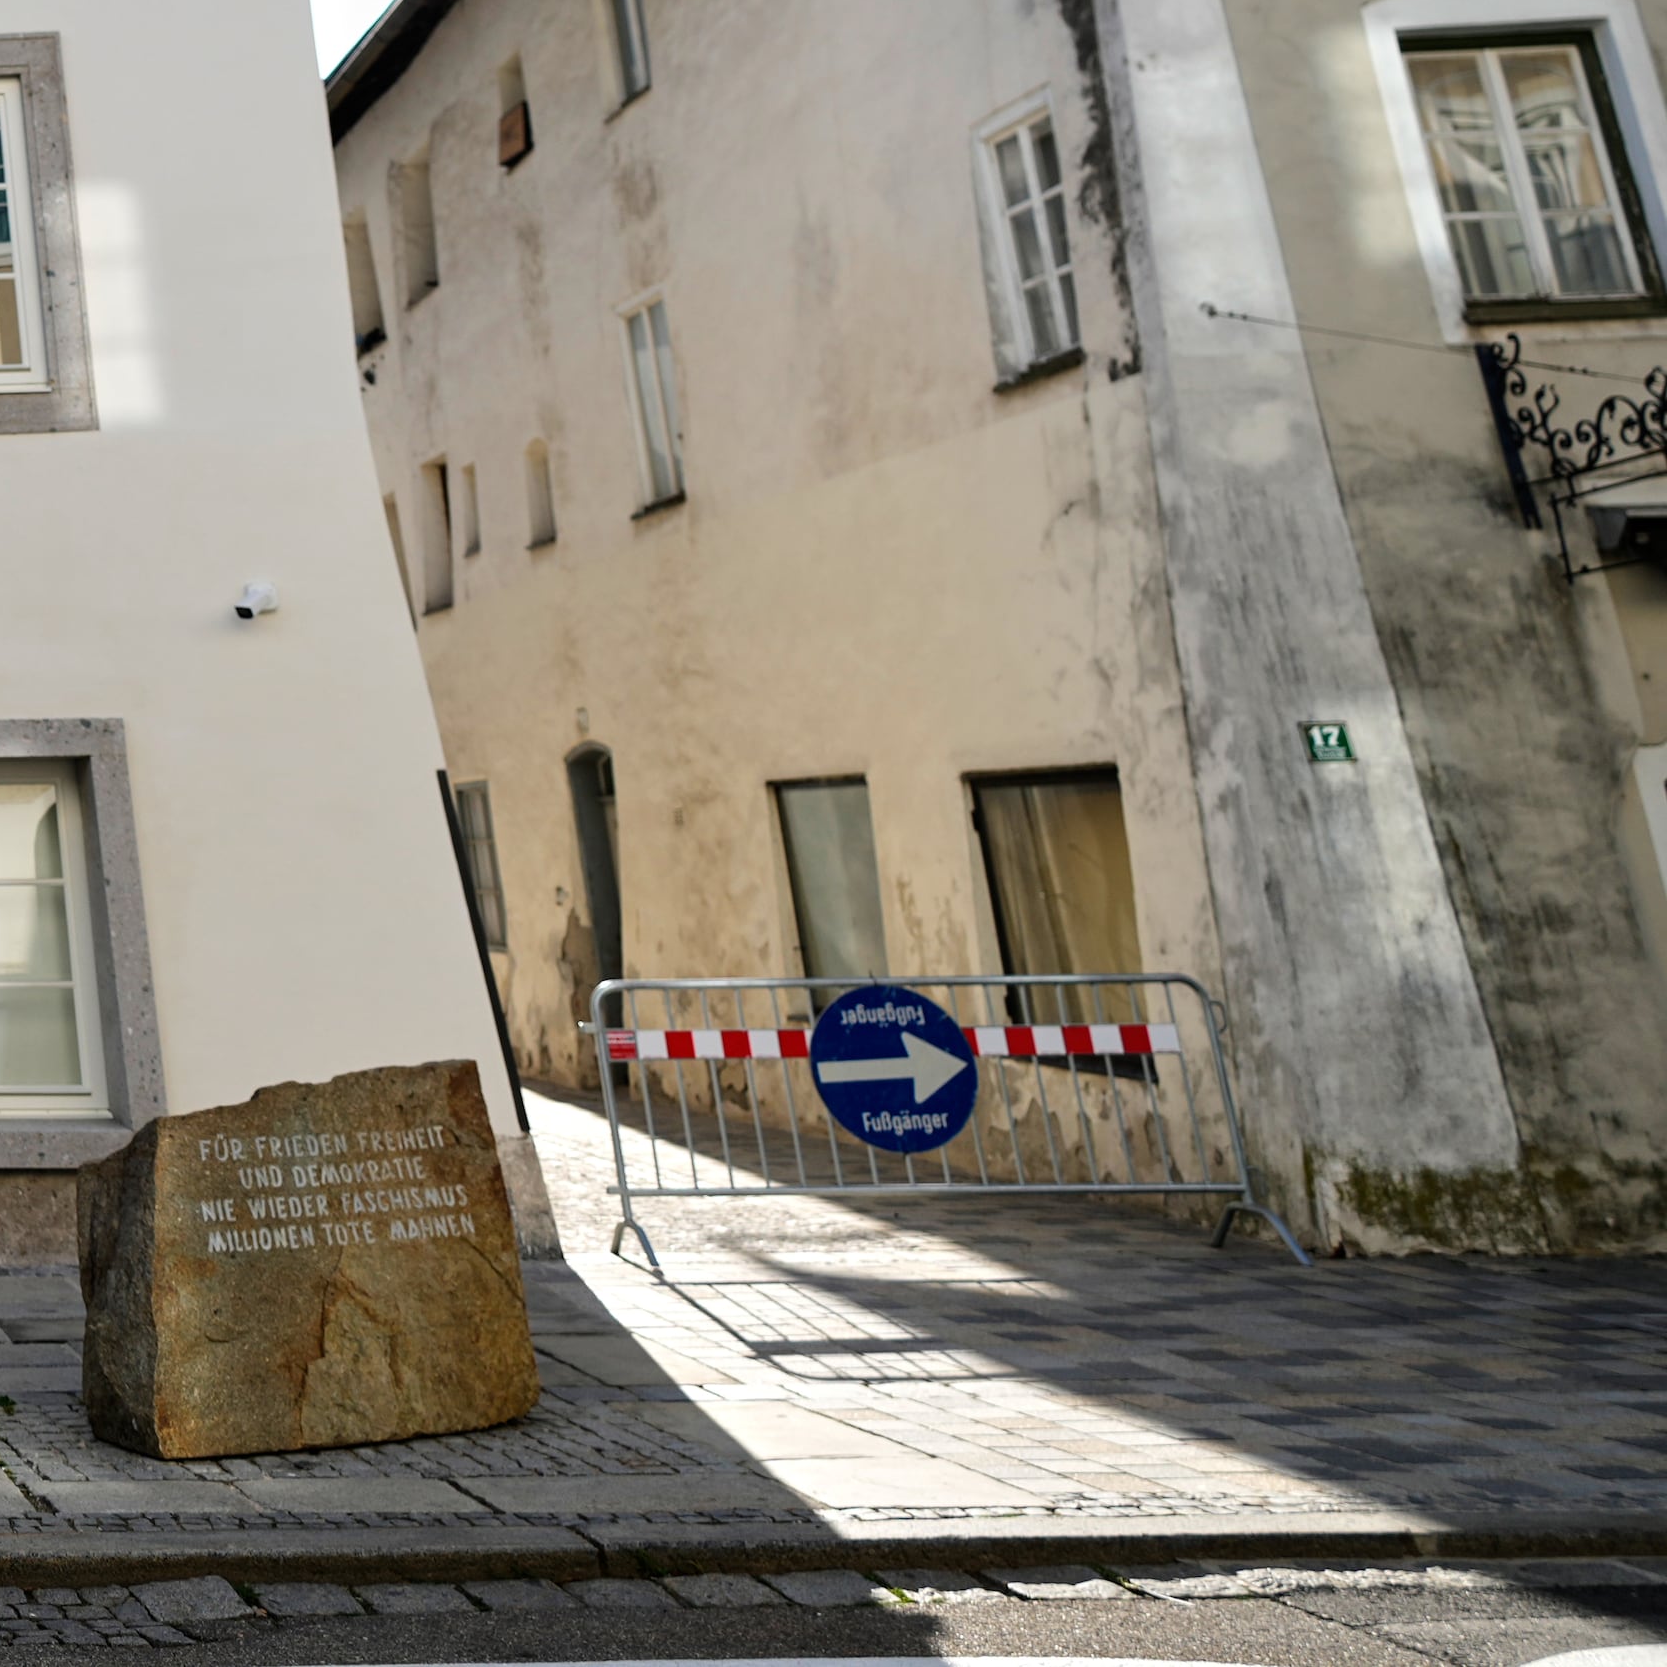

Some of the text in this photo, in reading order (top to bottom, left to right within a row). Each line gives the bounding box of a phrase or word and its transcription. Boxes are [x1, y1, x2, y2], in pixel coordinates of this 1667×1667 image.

[1308, 724, 1340, 746] 17
[839, 1000, 926, 1028] Fußgänger
[860, 1109, 949, 1137] Fußgänger
[199, 1125, 444, 1161] FÜR FRIEDEN FREIHEIT
[239, 1156, 427, 1189] UND DEMOKRATIE
[200, 1184, 468, 1221] NIE WIEDER FASCHISMUS
[208, 1213, 475, 1252] MILLIONEN TOTE MAHNEN
